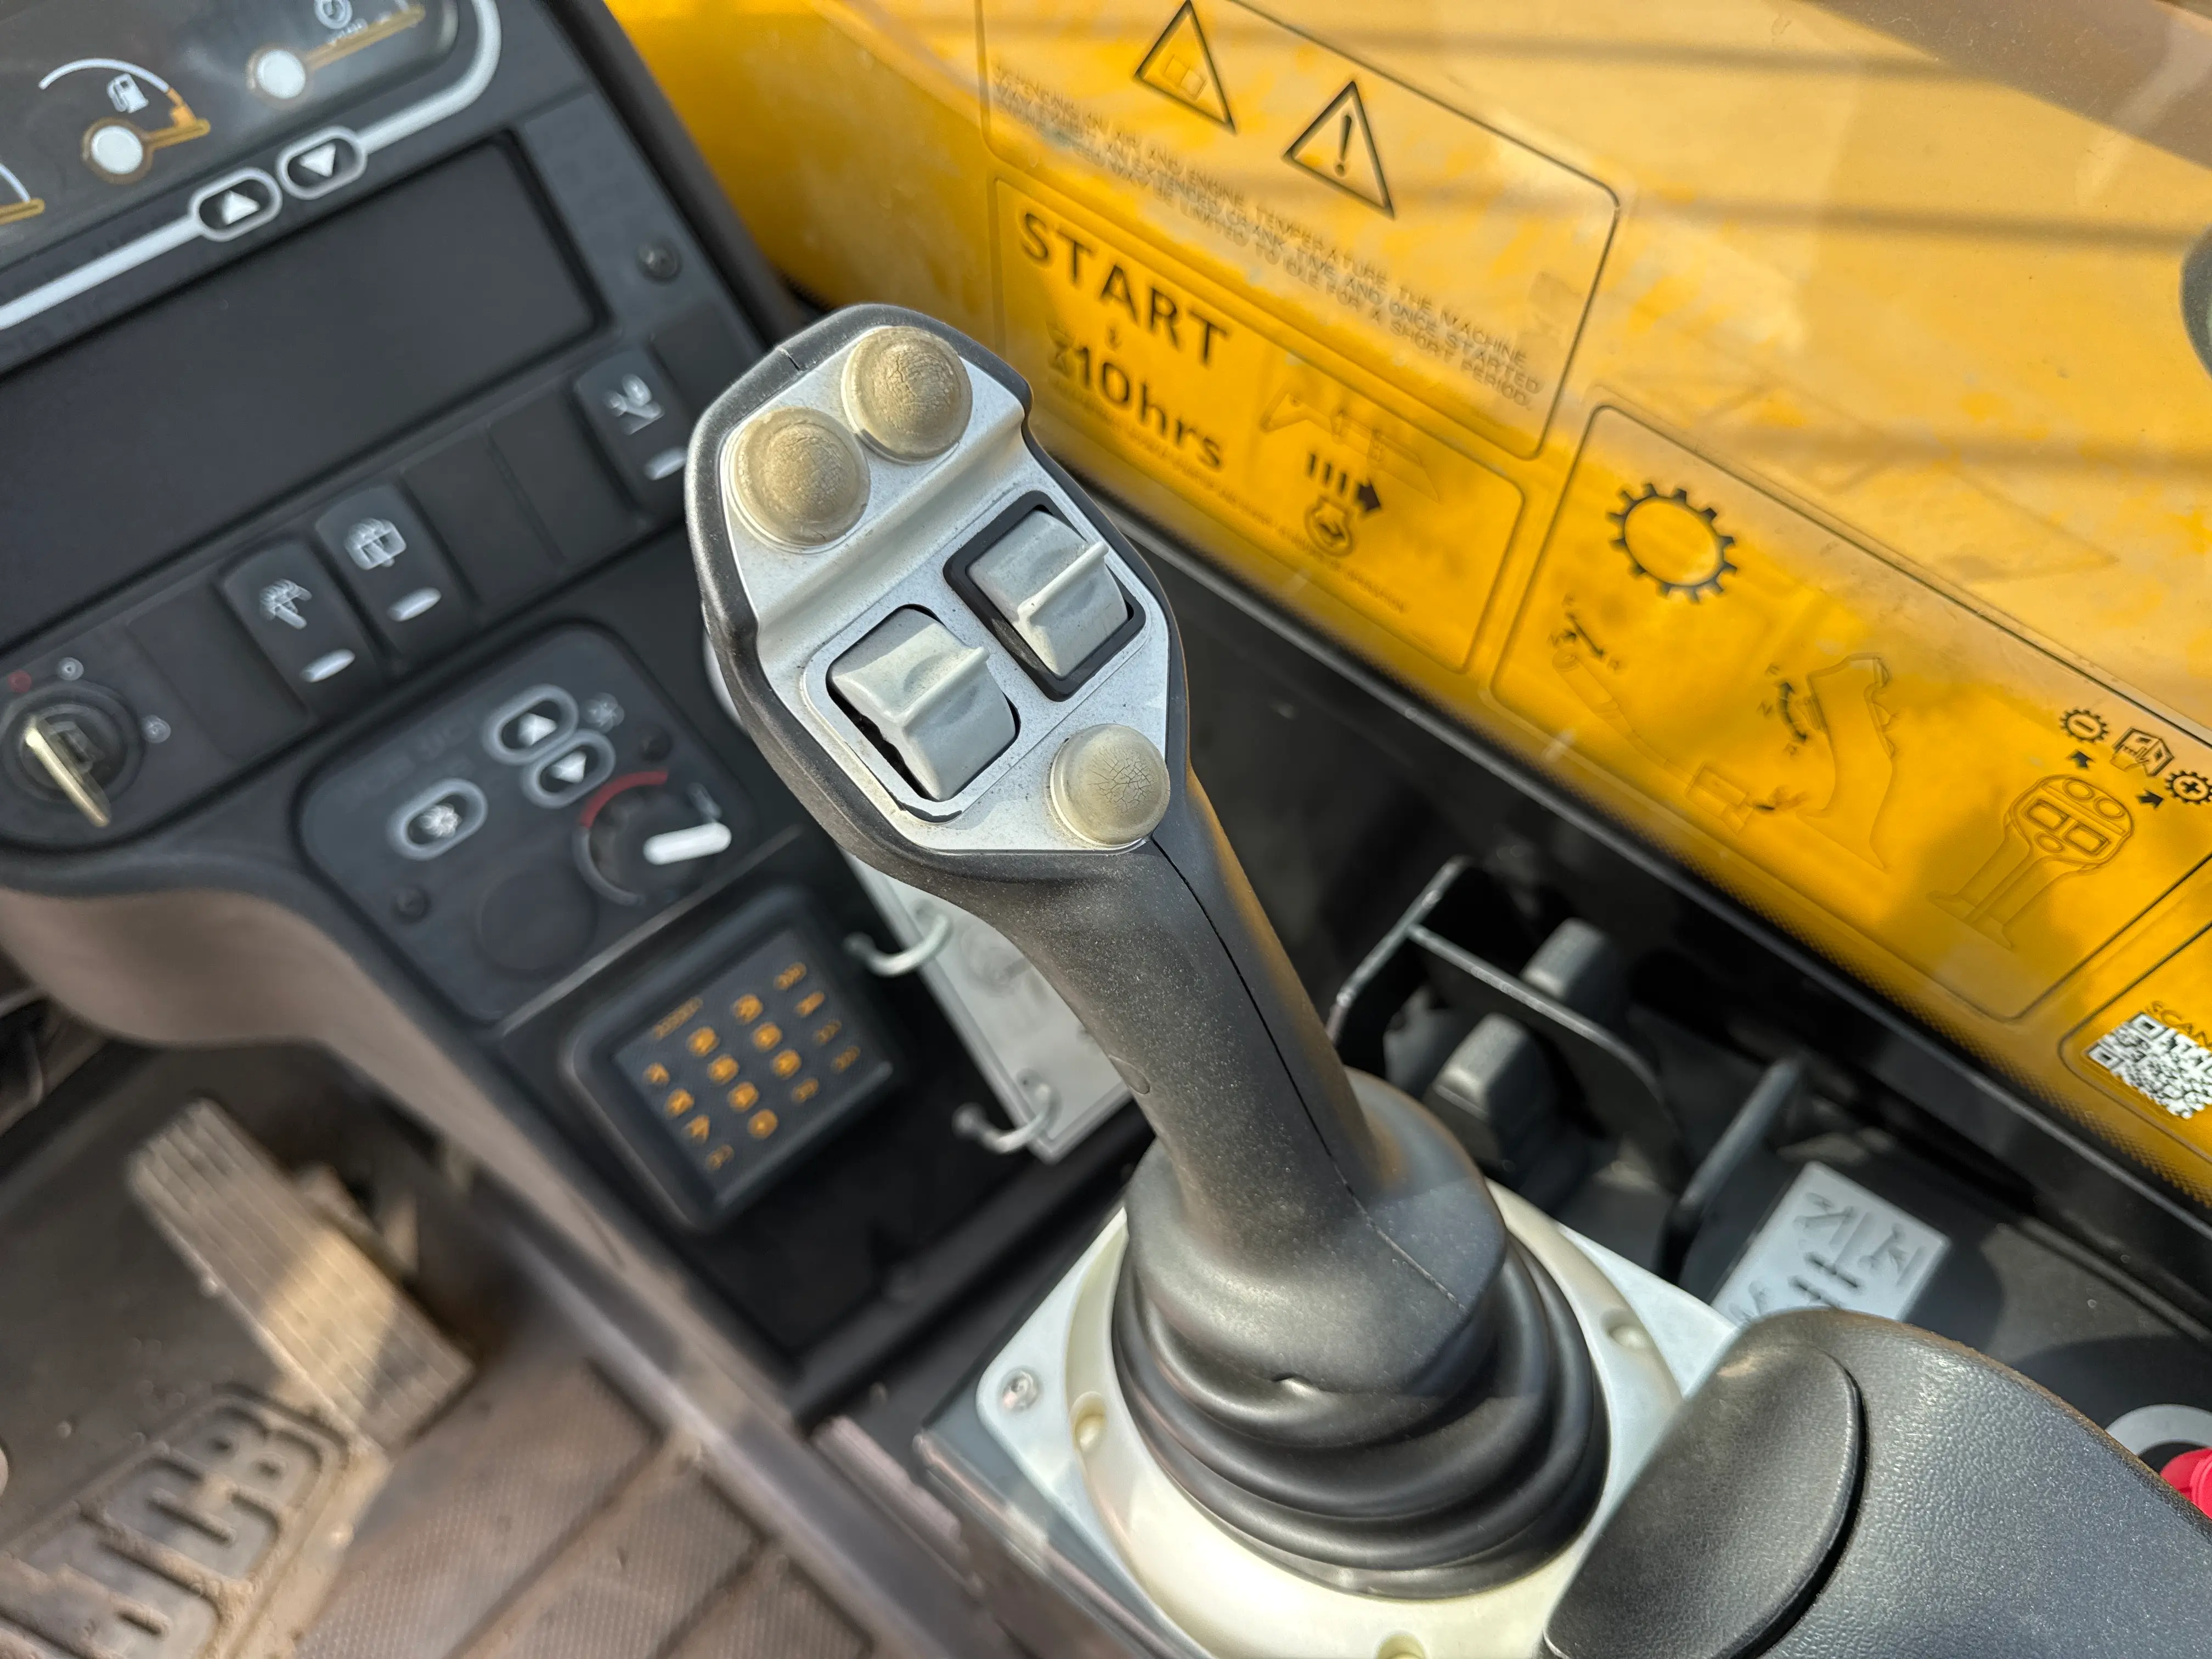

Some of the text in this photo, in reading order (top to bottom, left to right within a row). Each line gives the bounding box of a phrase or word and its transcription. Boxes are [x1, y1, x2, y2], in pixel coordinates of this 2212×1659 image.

[1022, 212, 1230, 365] START
[1255, 201, 1389, 294] TEMPERATURE
[1399, 286, 1432, 313] THE
[1440, 306, 1527, 365] MACHINE
[1294, 246, 1337, 282] TIME
[1344, 273, 1385, 306] AND
[1389, 301, 1437, 338] ONCE
[1444, 330, 1546, 395] STARTED
[1325, 278, 1366, 317] FOR
[1390, 318, 1454, 363] SHORT
[1074, 346, 1223, 471] 10hrs
